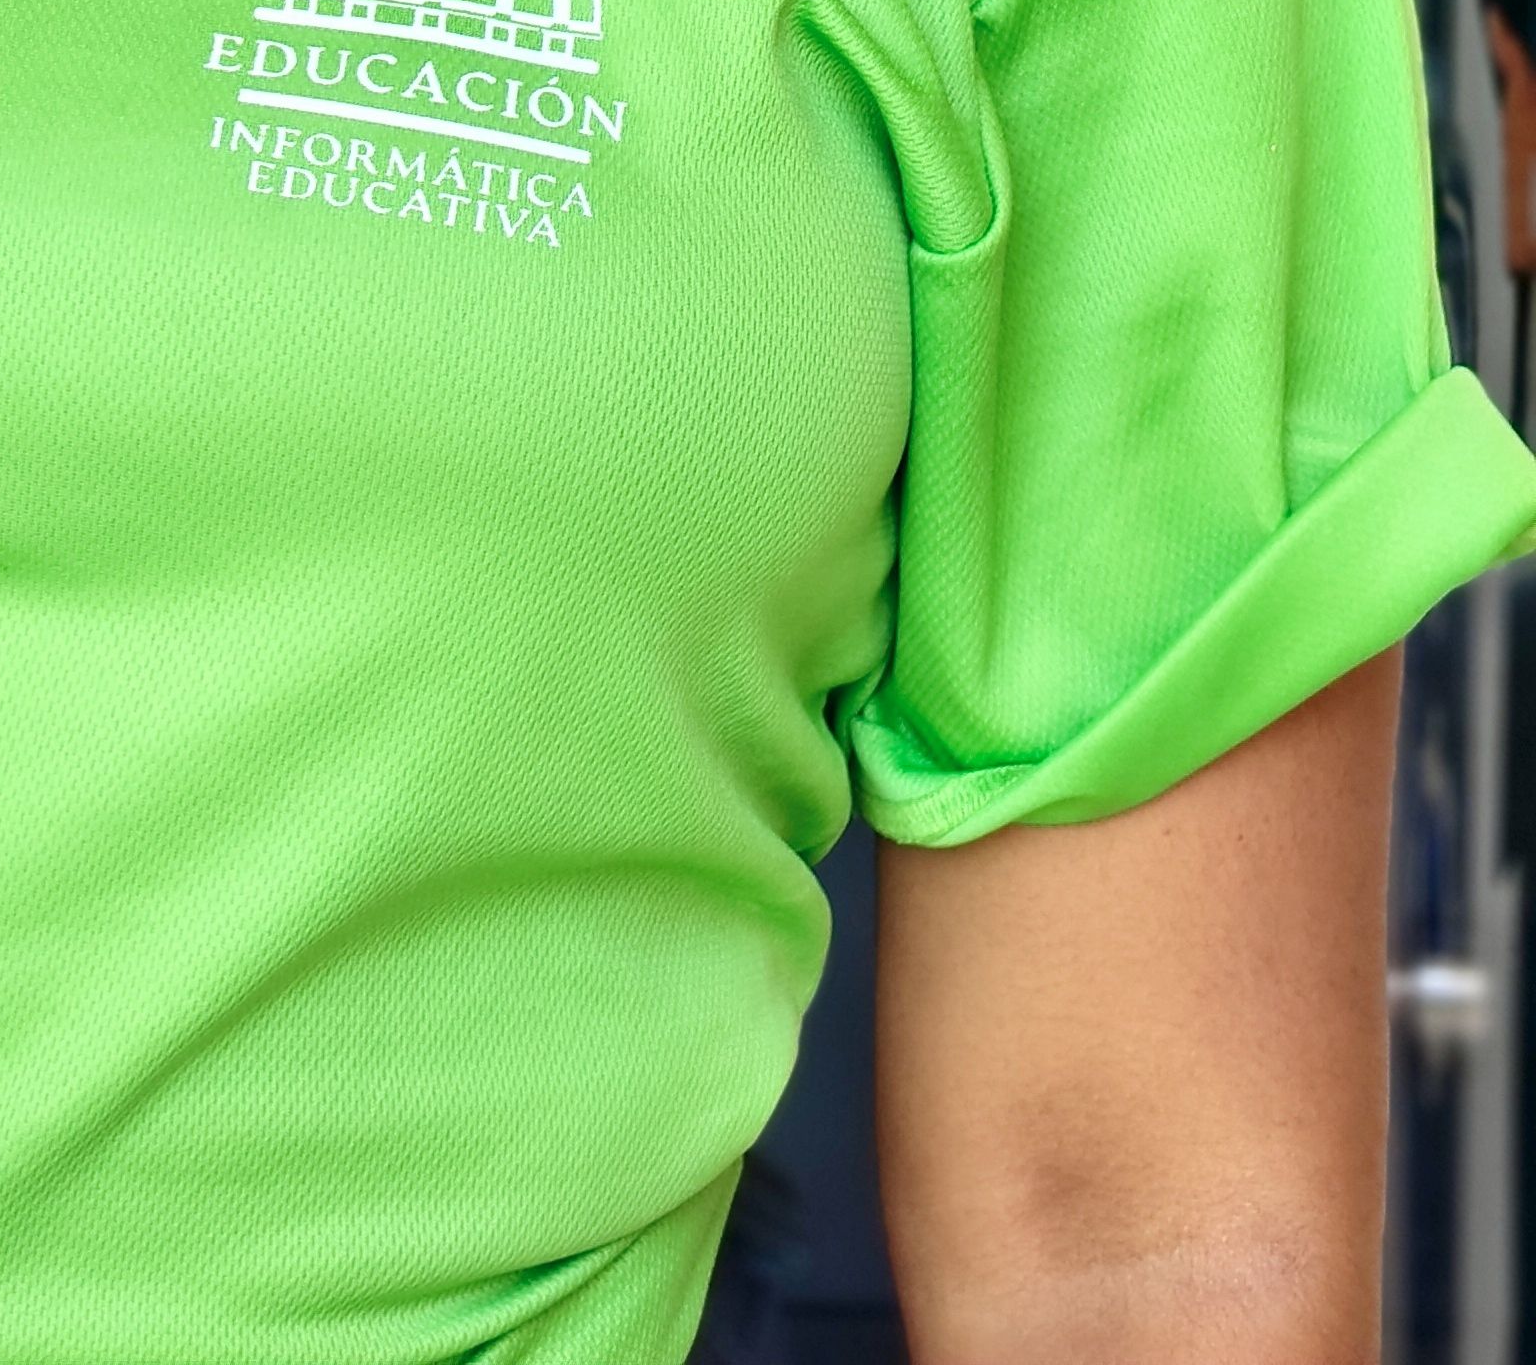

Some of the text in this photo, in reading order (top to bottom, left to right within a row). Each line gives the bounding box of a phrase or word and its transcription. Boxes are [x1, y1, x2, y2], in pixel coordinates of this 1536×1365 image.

[202, 32, 628, 142] EDUCACIÓN
[209, 115, 594, 219] INFORMÁTICA
[246, 159, 561, 248] EDUCATIVA
